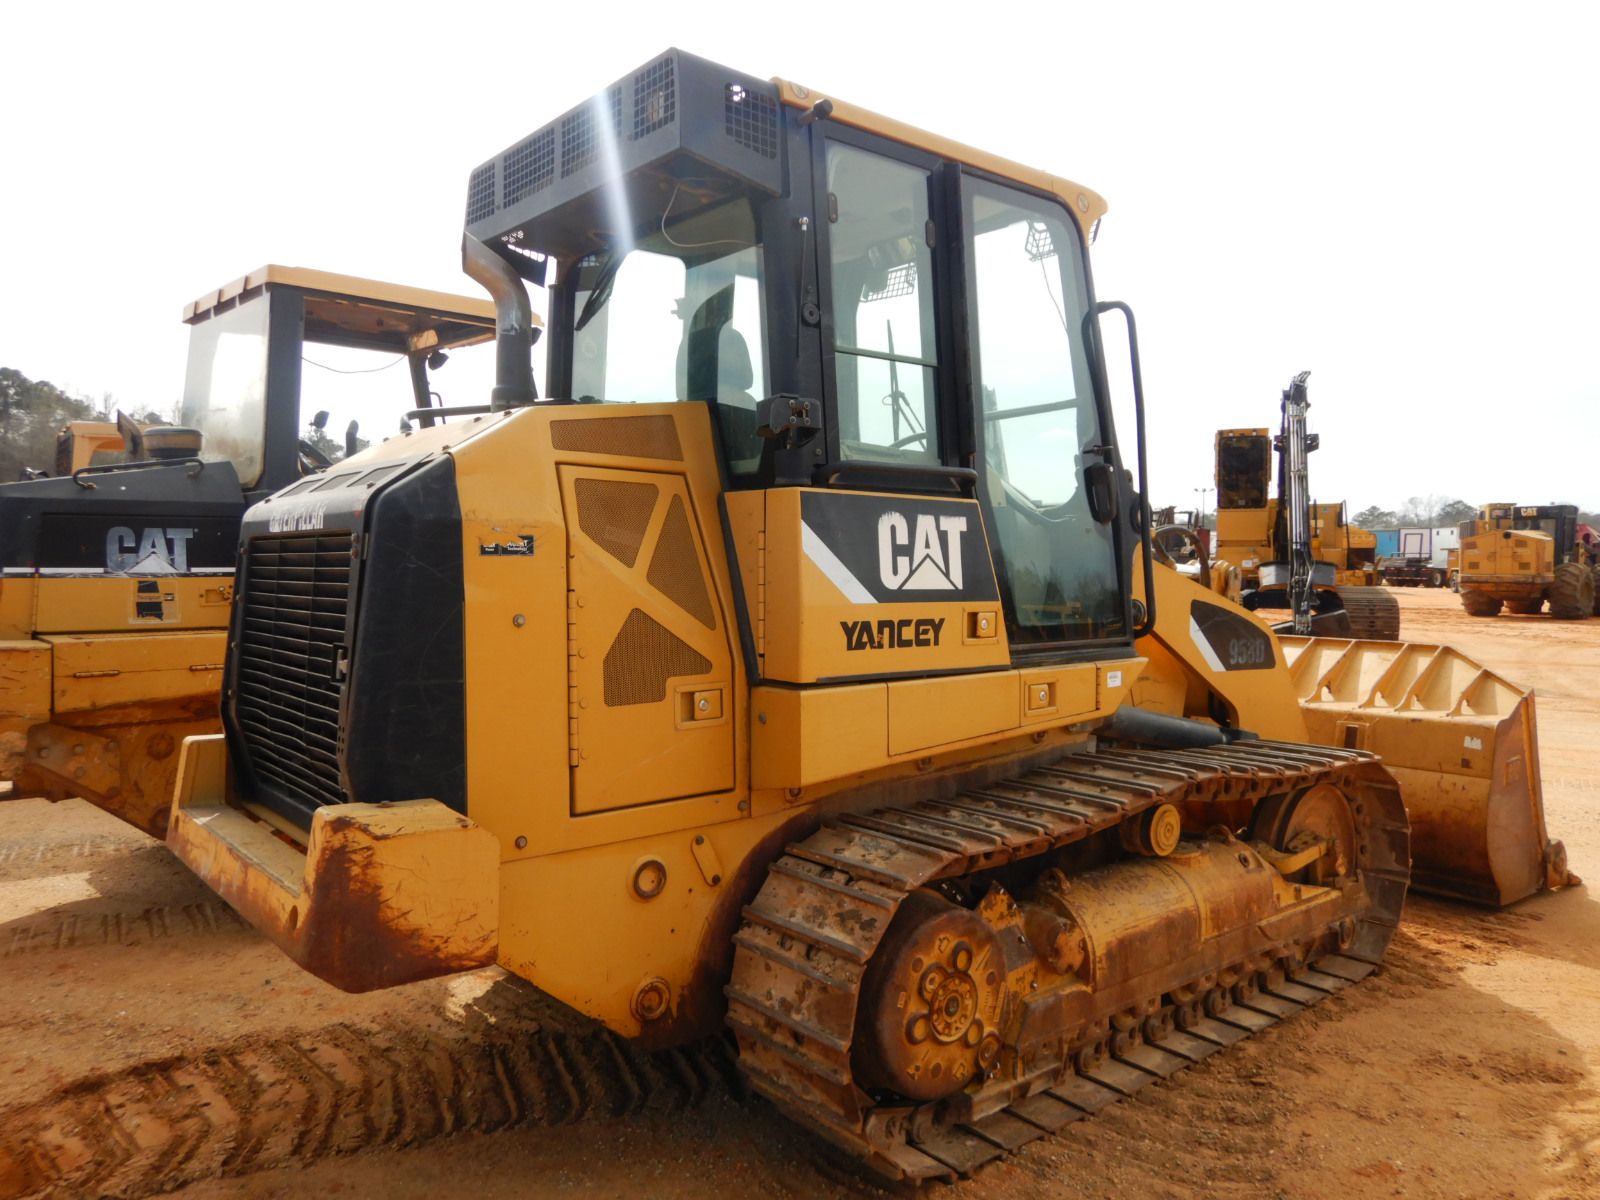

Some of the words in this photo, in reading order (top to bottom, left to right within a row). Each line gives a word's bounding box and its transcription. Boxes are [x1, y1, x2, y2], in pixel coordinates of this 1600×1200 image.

[106, 526, 193, 573] CAT
[878, 511, 967, 590] CAT
[840, 618, 945, 651] YANCEY
